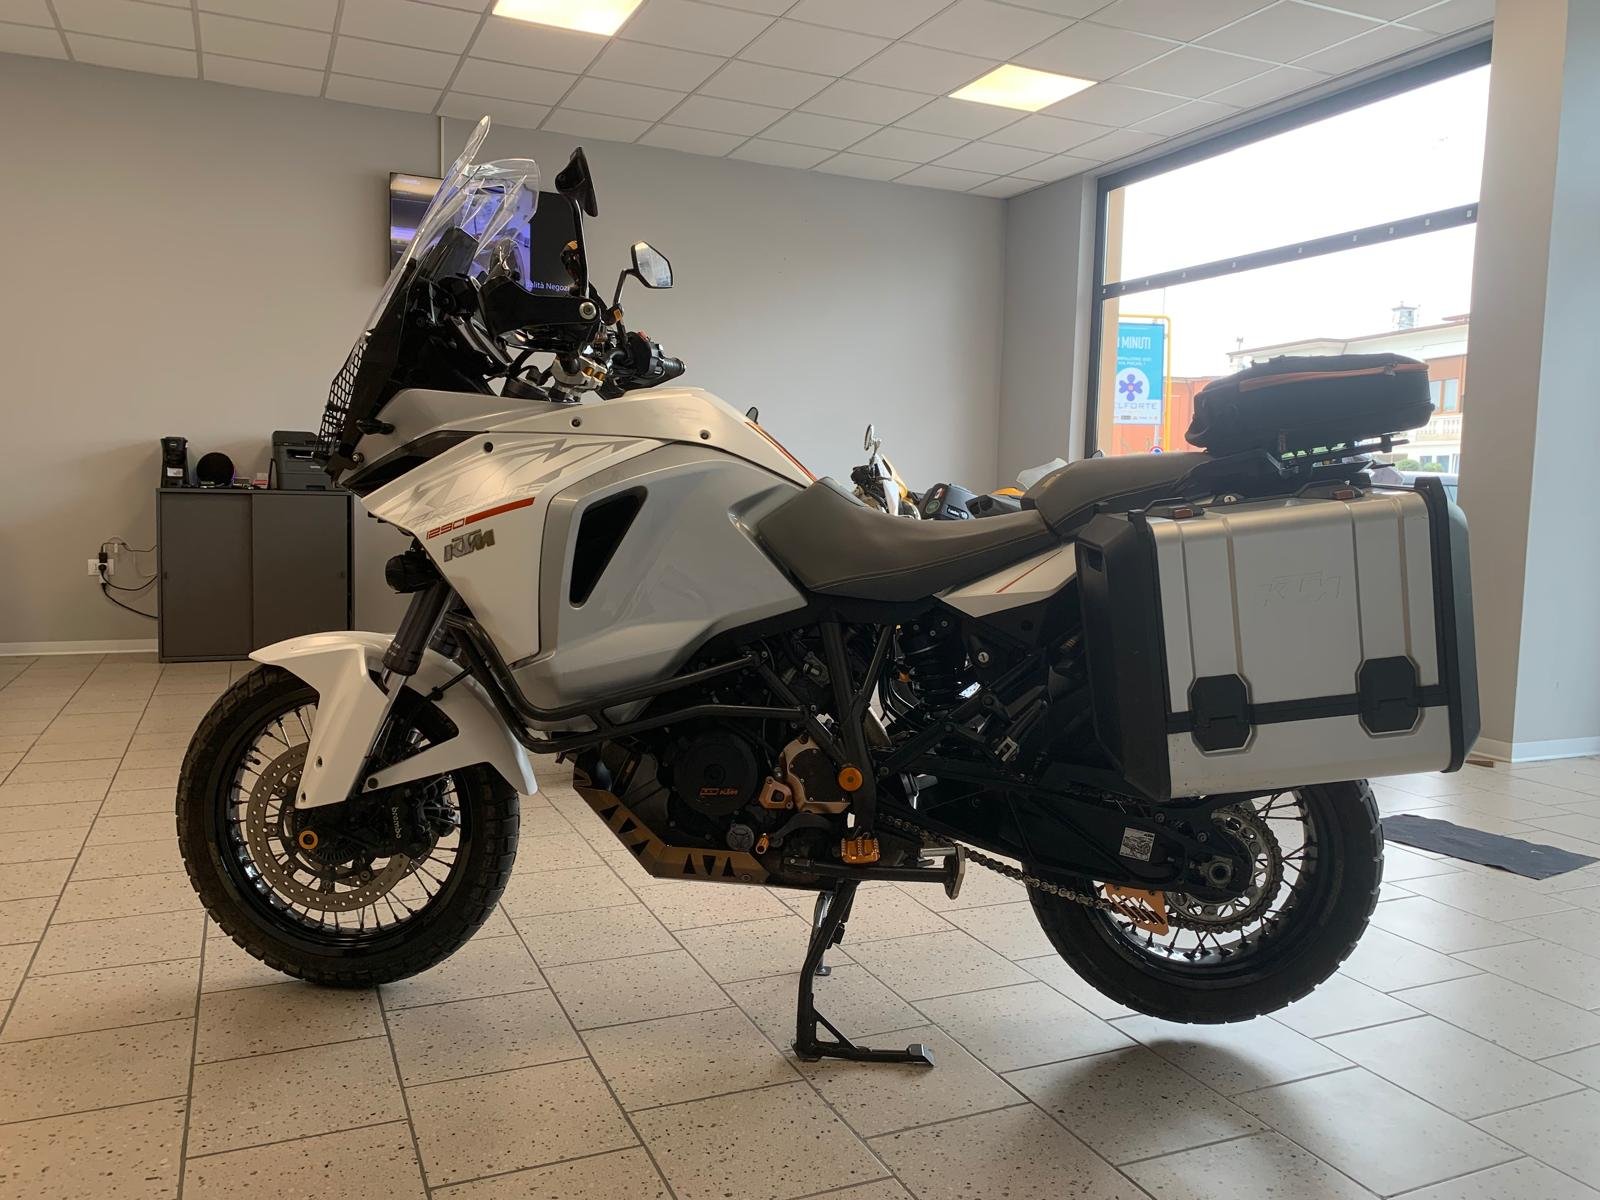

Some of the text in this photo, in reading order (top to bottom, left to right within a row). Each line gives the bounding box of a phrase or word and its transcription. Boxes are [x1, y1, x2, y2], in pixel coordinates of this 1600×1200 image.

[526, 280, 570, 292] alità Negozi
[1121, 336, 1151, 350] MINUTI
[1117, 402, 1158, 410] LFORTE
[443, 529, 496, 562] KTM
[391, 806, 402, 839] brembo
